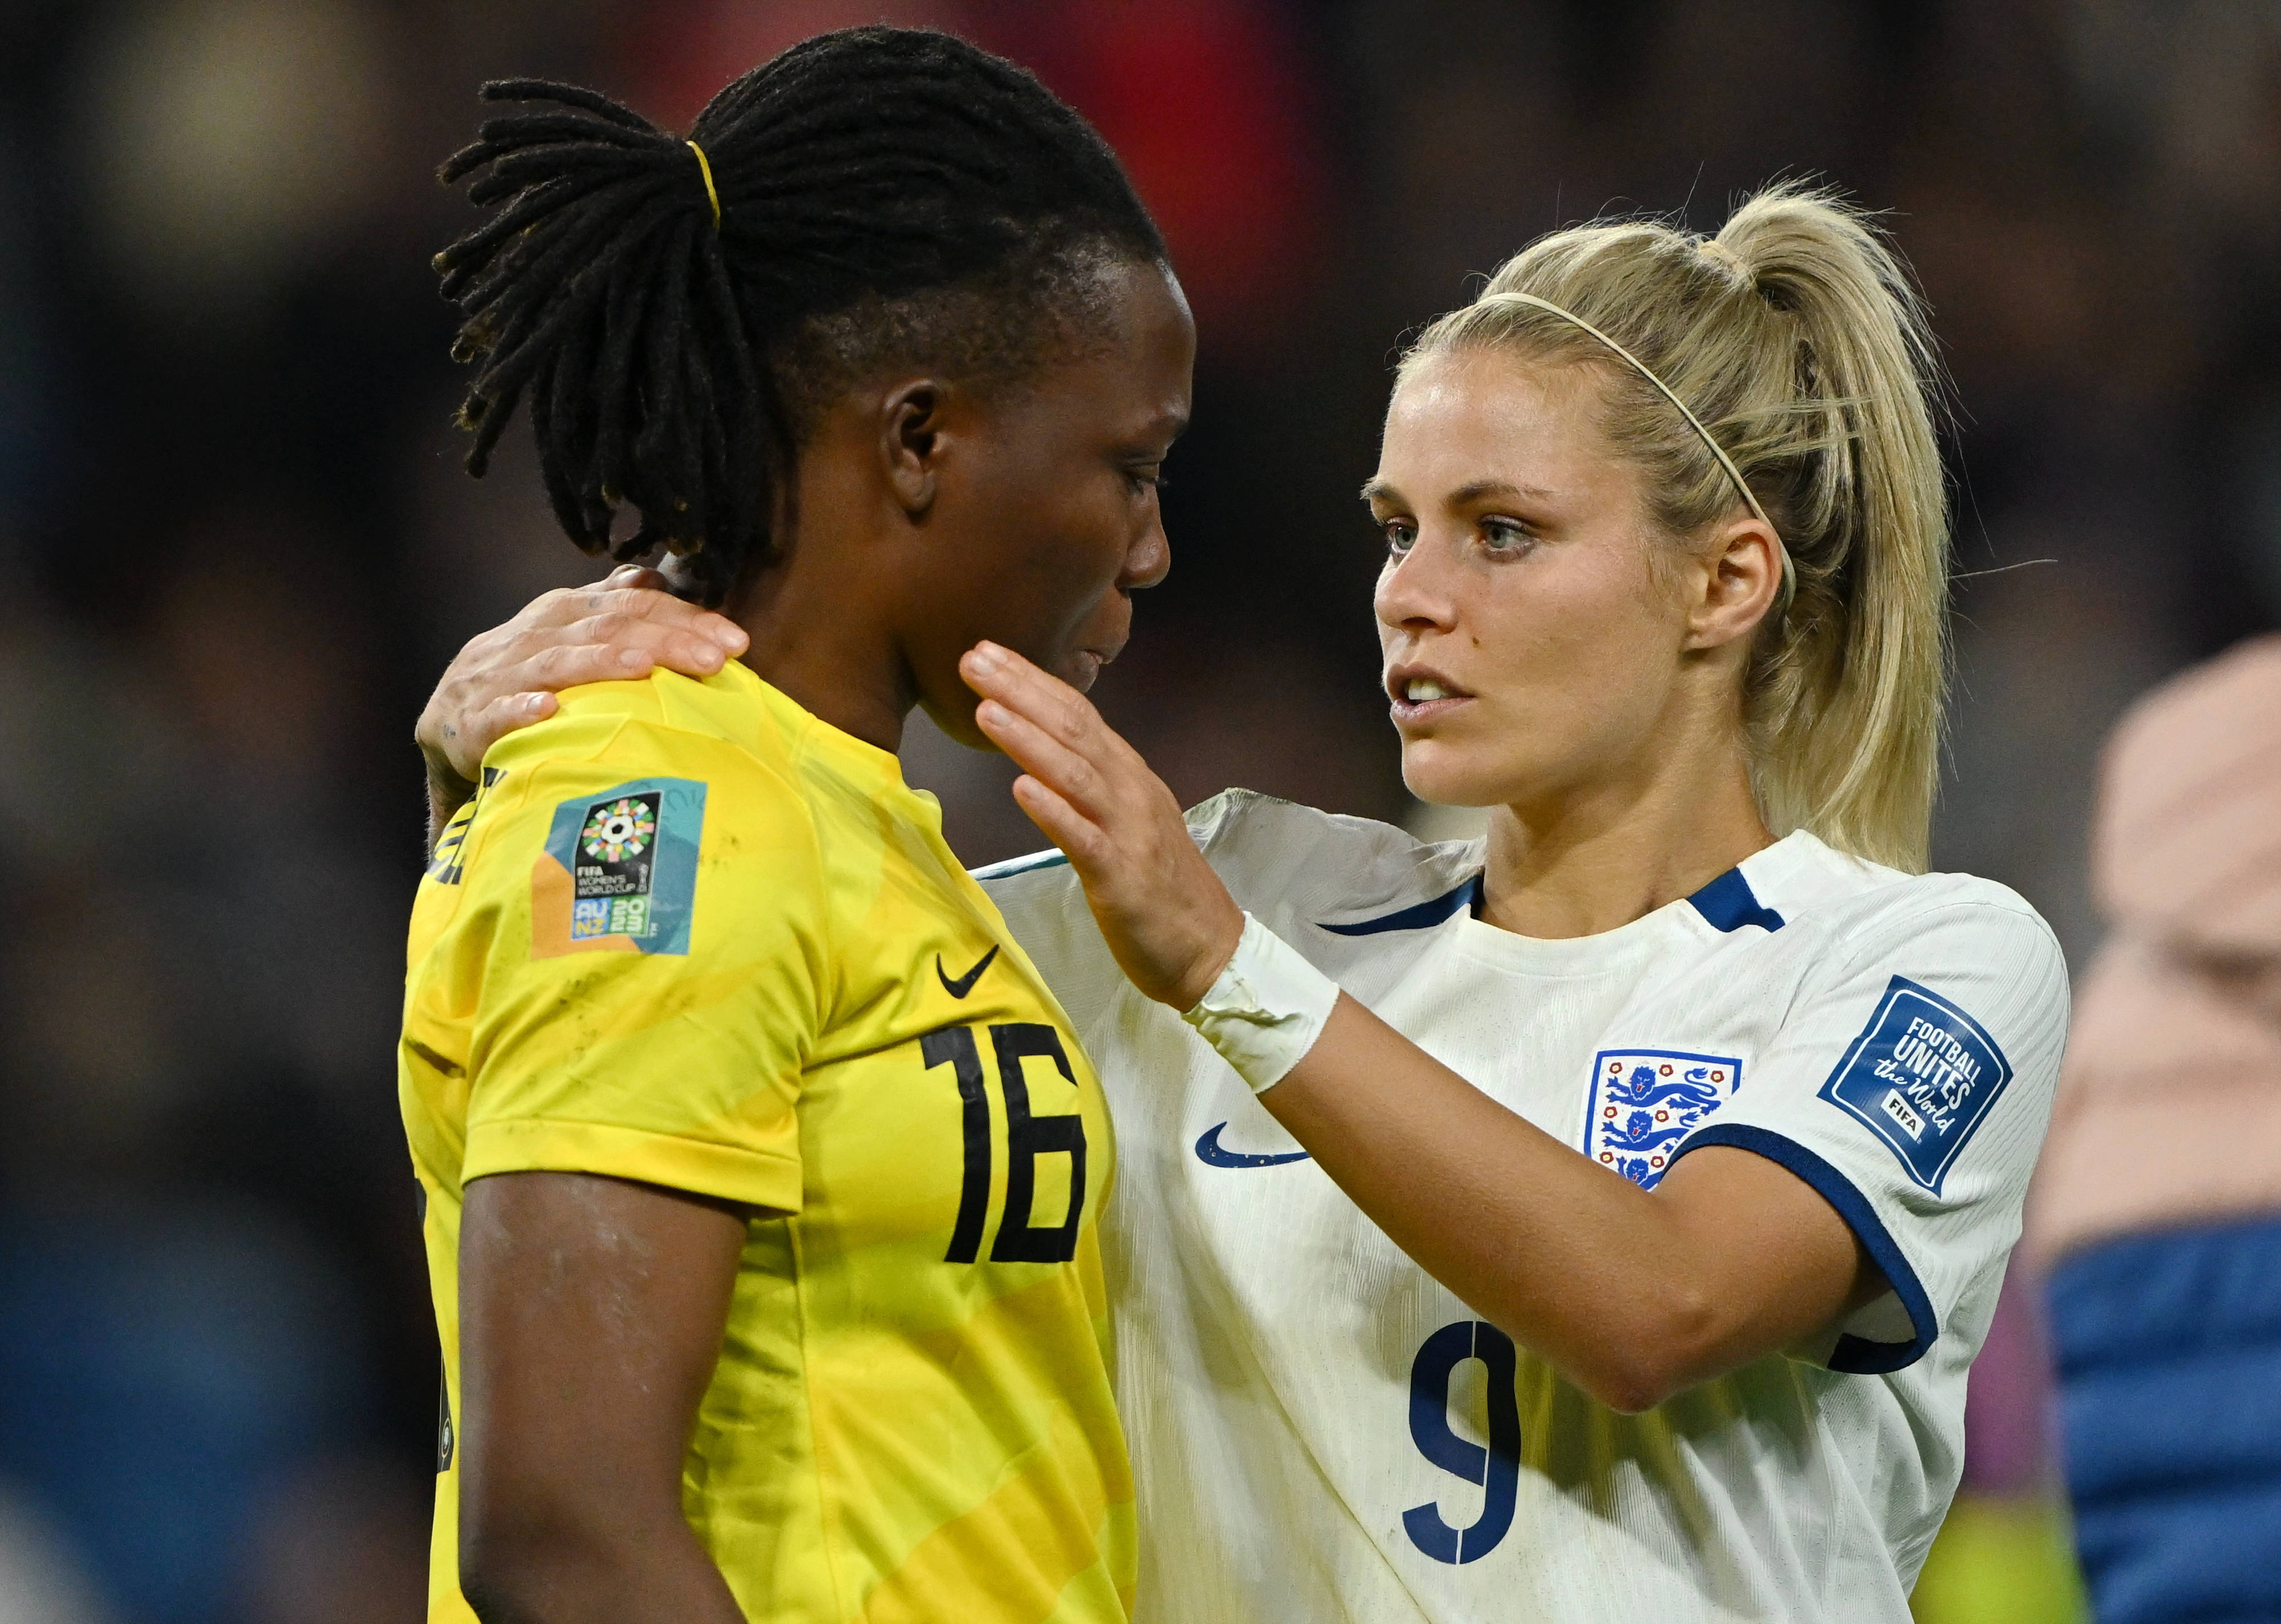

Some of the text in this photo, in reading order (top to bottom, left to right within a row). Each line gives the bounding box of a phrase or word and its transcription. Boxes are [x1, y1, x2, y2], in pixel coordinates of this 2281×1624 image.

[577, 866, 604, 876] FIFA
[579, 883, 636, 895] WORLD CUP
[575, 900, 608, 920] AU
[613, 899, 644, 915] 20
[575, 918, 604, 935] NZ
[610, 915, 643, 931] 23
[1907, 1017, 1981, 1087] FOOTBALL
[1893, 1034, 1970, 1110] UNITES
[1874, 1059, 1955, 1136] the World
[1889, 1098, 1917, 1132] FIFA
[920, 1023, 1086, 1263] 16
[1402, 1321, 1521, 1565] 9
